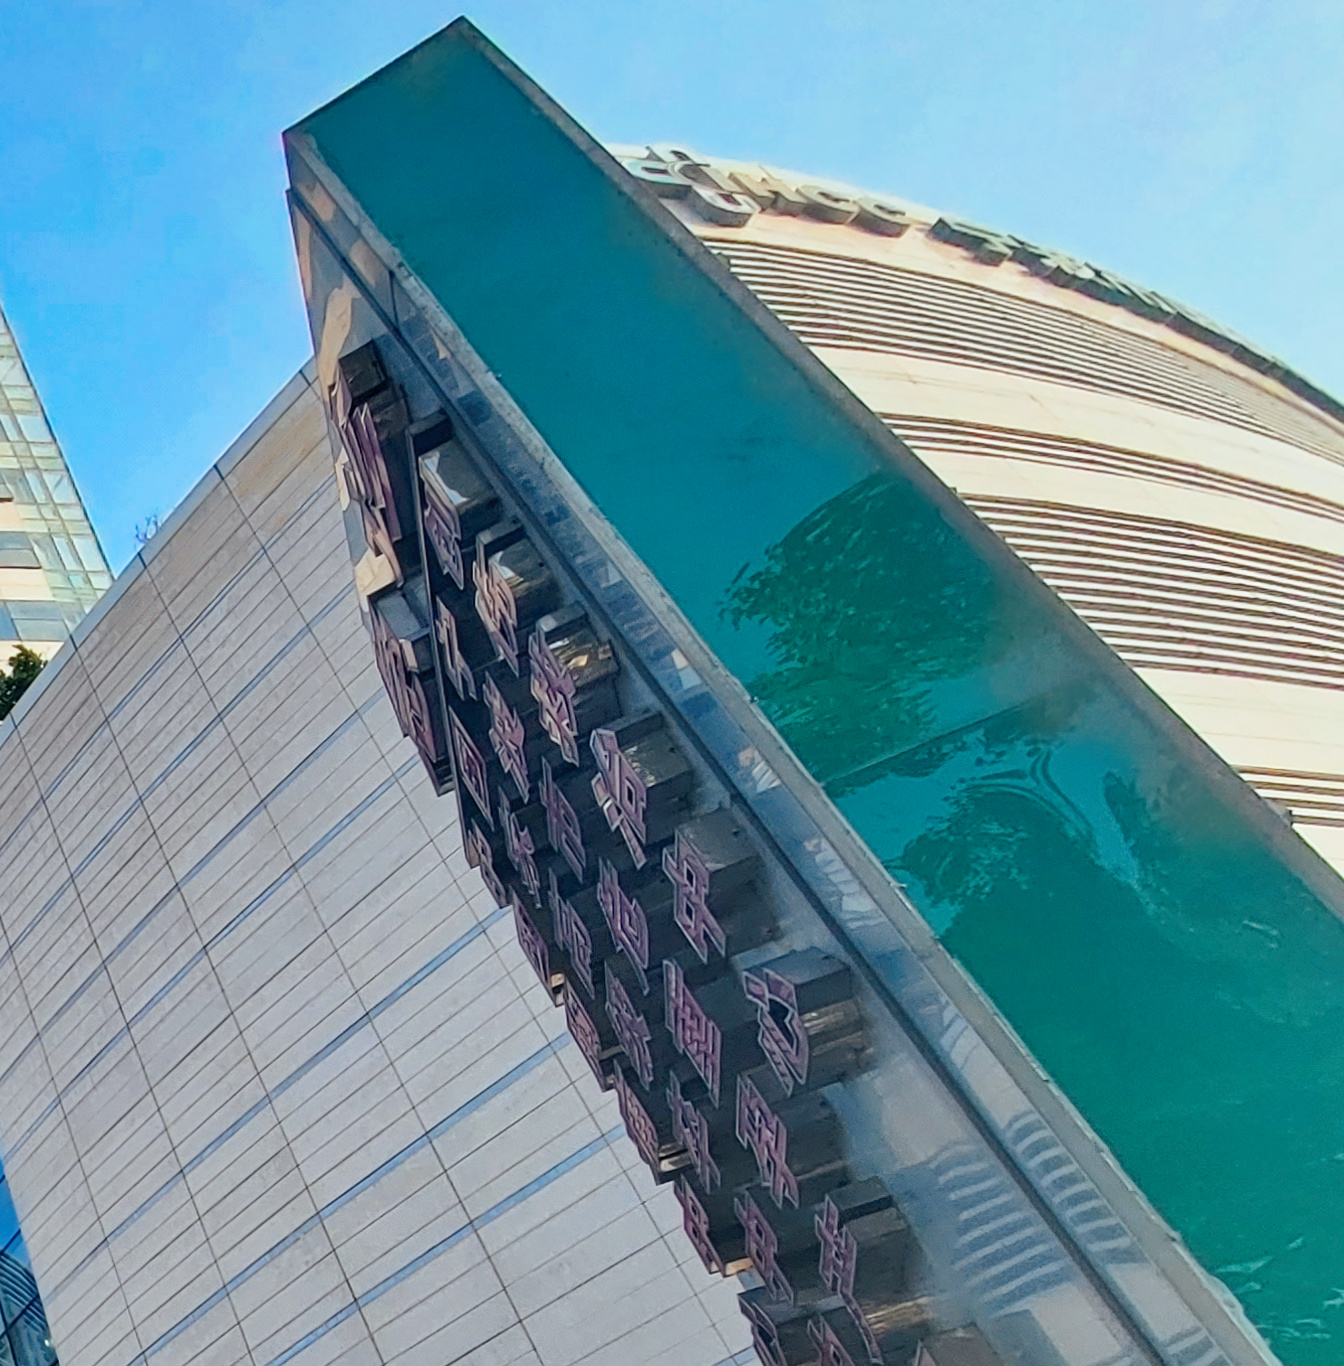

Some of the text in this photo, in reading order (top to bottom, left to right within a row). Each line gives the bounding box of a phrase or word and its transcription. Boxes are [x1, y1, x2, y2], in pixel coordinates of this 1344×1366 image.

[419, 447, 809, 1098] 创伤救治中心
